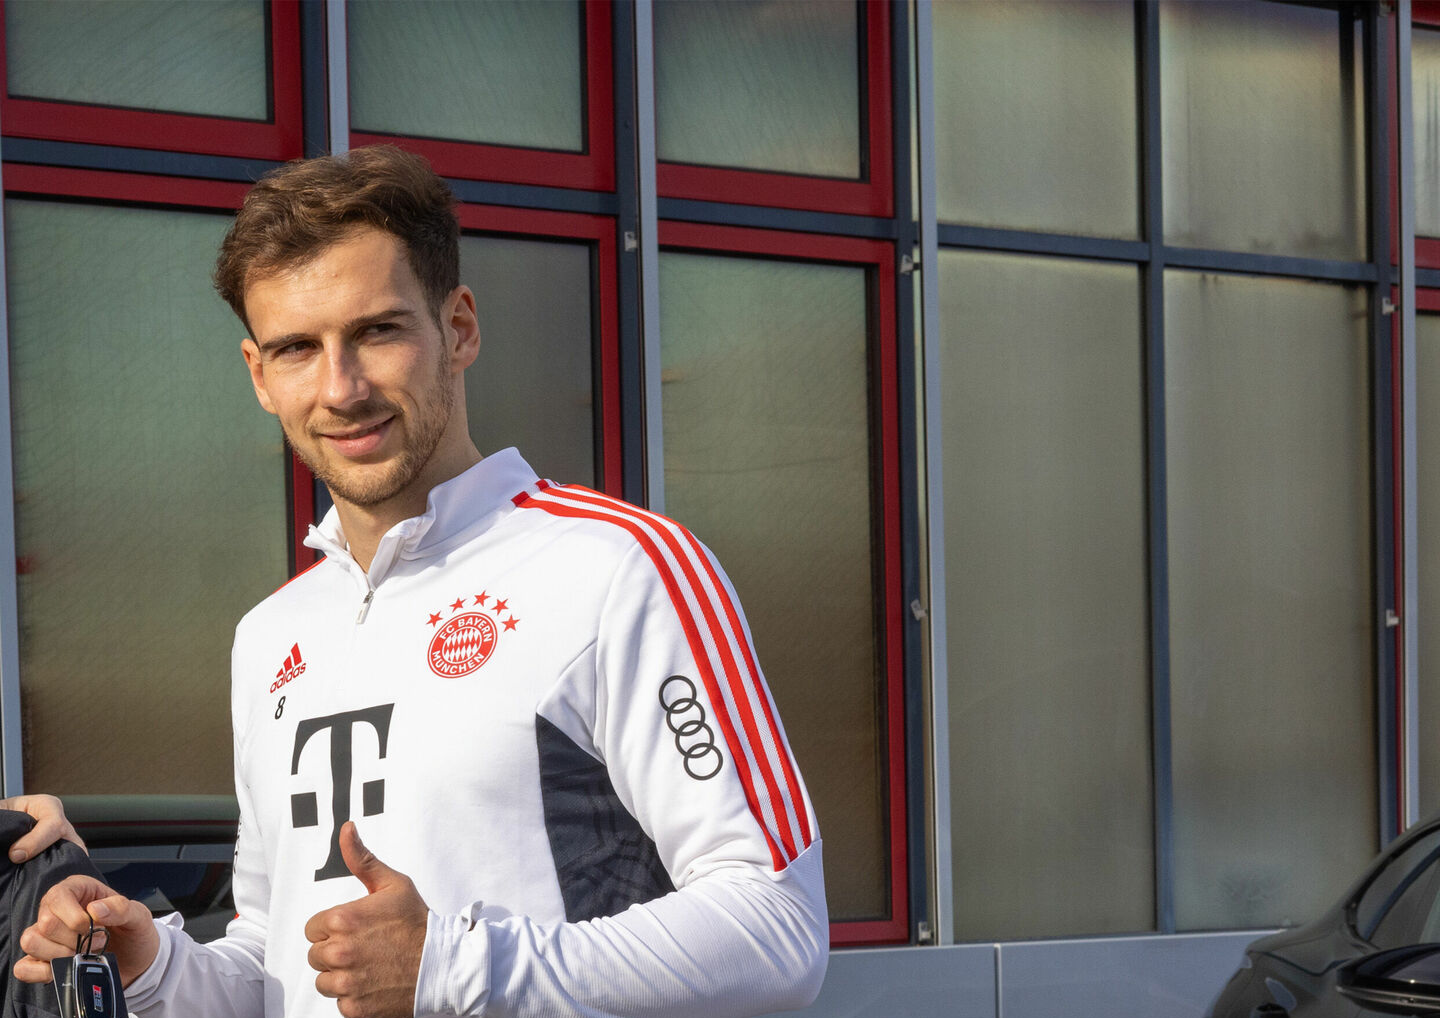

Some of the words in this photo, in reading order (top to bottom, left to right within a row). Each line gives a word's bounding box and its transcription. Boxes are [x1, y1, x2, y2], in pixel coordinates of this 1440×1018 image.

[440, 624, 455, 640] FC
[457, 616, 493, 642] BAYERN
[269, 662, 307, 694] adidas
[274, 695, 286, 720] 8
